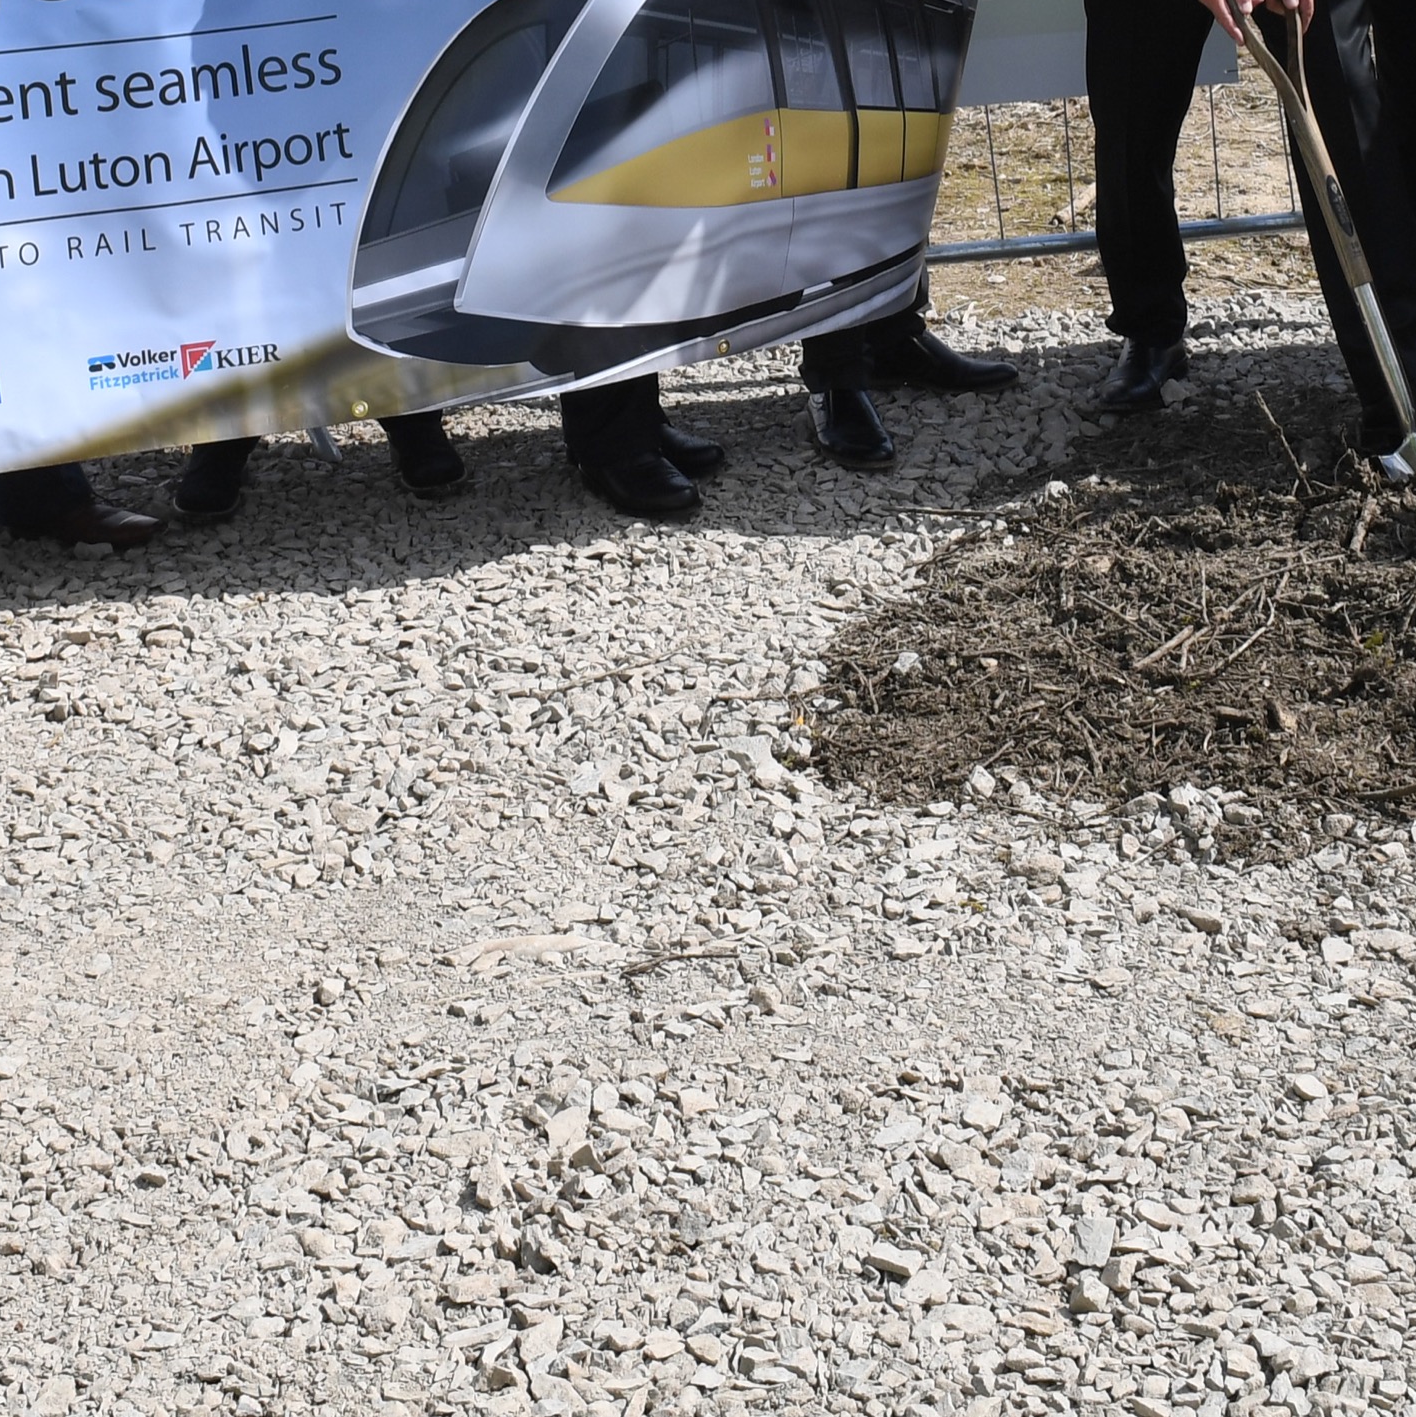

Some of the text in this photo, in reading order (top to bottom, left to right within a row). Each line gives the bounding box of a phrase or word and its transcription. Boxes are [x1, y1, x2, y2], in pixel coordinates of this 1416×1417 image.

[96, 44, 342, 112] seamless
[30, 151, 172, 197] Luton
[188, 122, 353, 182] Airport
[67, 229, 157, 260] RAIL
[179, 202, 346, 246] TRANSIT
[117, 348, 178, 368] Volker
[215, 343, 282, 369] KIER
[89, 365, 179, 390] Fitzpatrick
